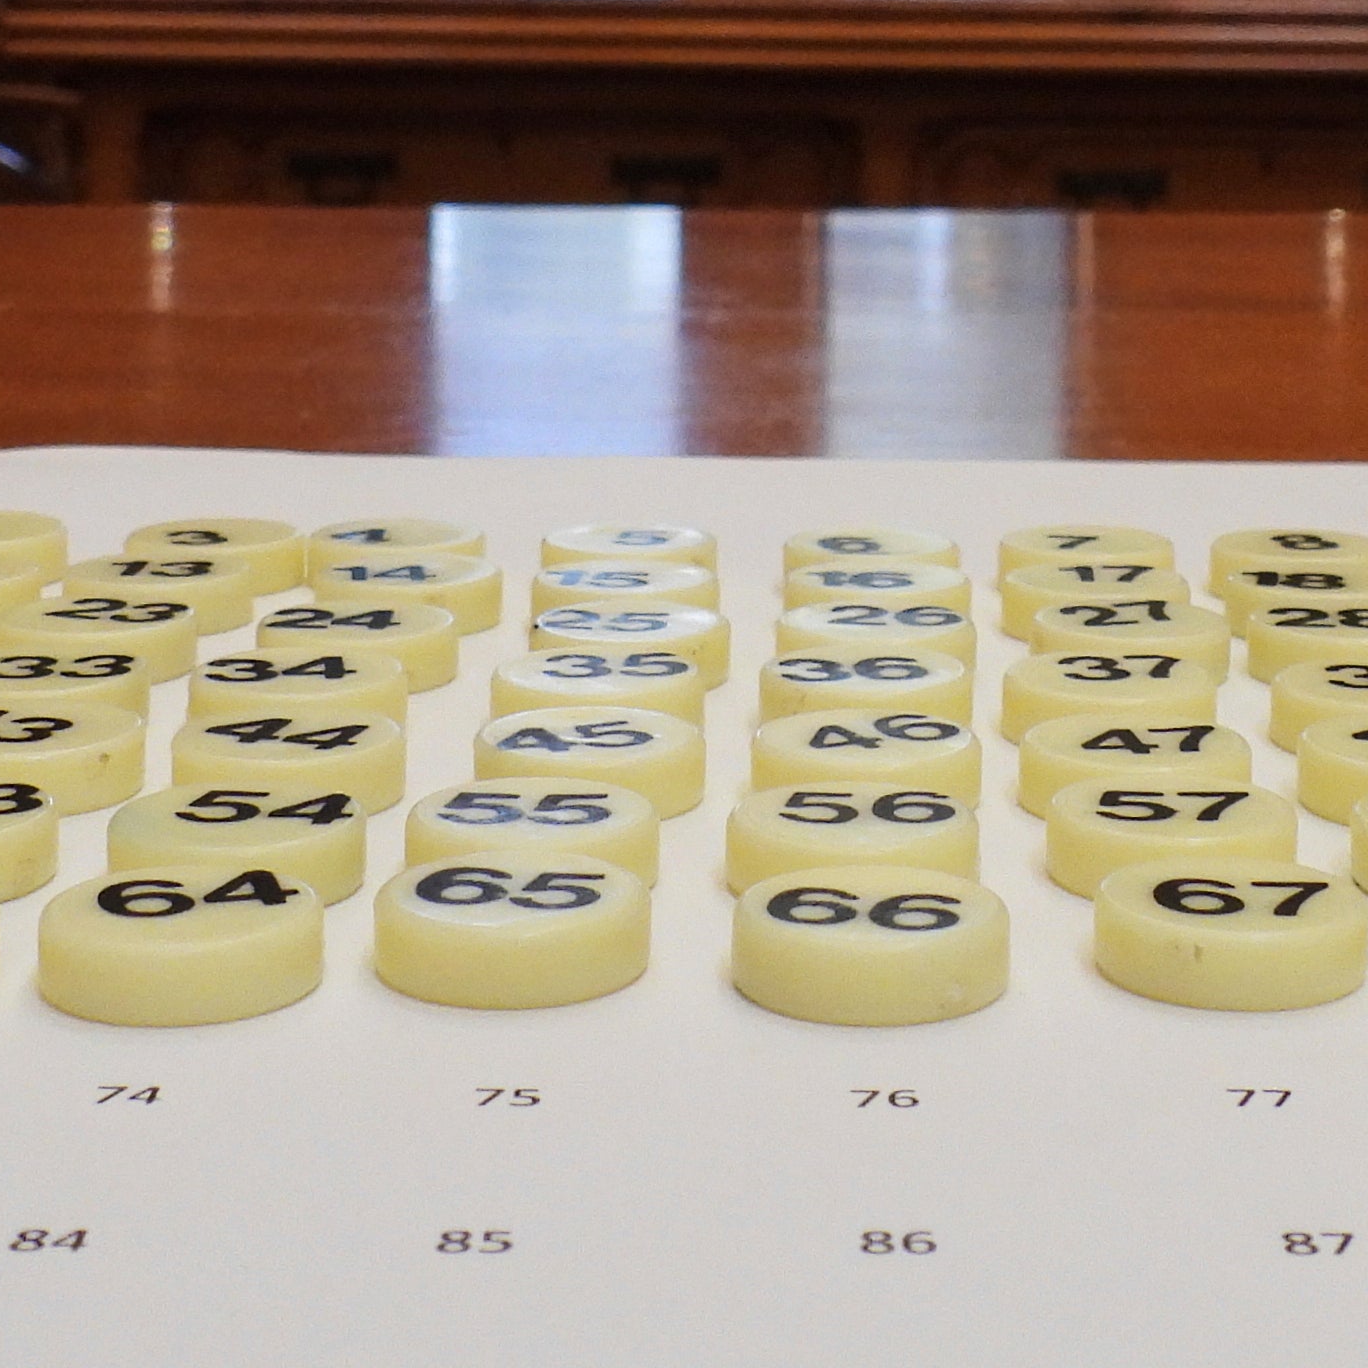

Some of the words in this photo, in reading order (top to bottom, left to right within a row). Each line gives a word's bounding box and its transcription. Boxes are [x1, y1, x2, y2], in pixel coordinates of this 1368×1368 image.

[166, 530, 229, 546] 3
[330, 528, 390, 544] 4
[613, 530, 670, 546] 5
[816, 536, 882, 555] 6
[1048, 535, 1099, 550] 7
[1270, 534, 1339, 551] 8
[111, 560, 214, 578] 13
[333, 565, 437, 582] 14
[546, 570, 650, 588] 15
[808, 570, 915, 589] 16
[1059, 565, 1154, 583] 17
[1241, 571, 1347, 590] 18
[44, 597, 189, 624] 23
[264, 607, 401, 630] 24
[542, 608, 670, 633] 25
[828, 604, 963, 627] 26
[1059, 599, 1171, 627] 27
[204, 656, 357, 683] 34
[542, 652, 689, 679] 35
[778, 656, 929, 682] 36
[1057, 654, 1181, 681] 37
[204, 717, 370, 751] 44
[496, 720, 654, 753] 45
[808, 713, 960, 749] 46
[1080, 725, 1216, 755] 47
[174, 790, 354, 825] 54
[437, 791, 613, 826] 55
[778, 791, 956, 825] 56
[1095, 790, 1250, 822] 57
[96, 869, 300, 918] 64
[415, 866, 606, 910] 65
[1152, 878, 1329, 917] 67
[766, 887, 962, 932] 66
[96, 1086, 160, 1105] 74
[476, 1088, 541, 1107] 75
[850, 1089, 920, 1108] 76
[1227, 1089, 1292, 1108] 77
[9, 1229, 87, 1252] 84
[436, 1231, 513, 1254] 85
[860, 1231, 937, 1255] 86
[1281, 1232, 1353, 1256] 87
